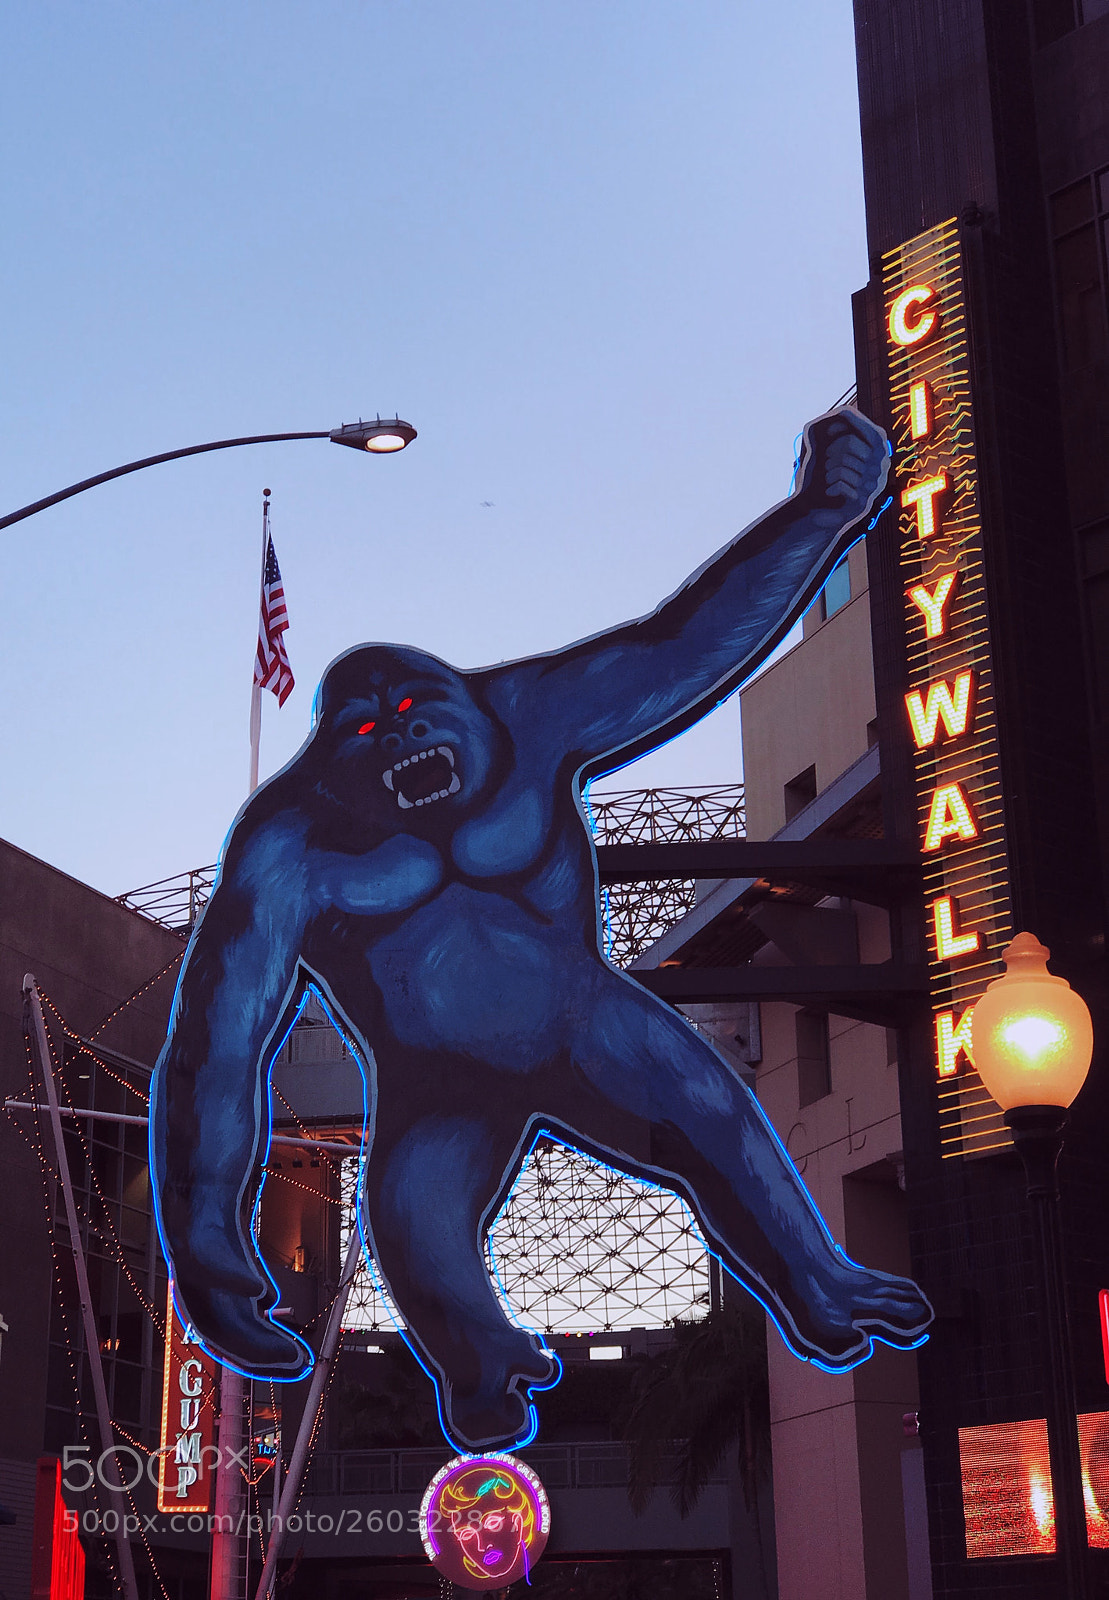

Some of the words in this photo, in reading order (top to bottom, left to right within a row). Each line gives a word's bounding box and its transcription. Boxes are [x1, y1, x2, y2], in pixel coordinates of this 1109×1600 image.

[889, 283, 980, 1078] CITYWALK
[174, 1359, 204, 1498] GUMP
[447, 1458, 461, 1470] THE
[516, 1463, 535, 1481] GIRLS
[432, 1467, 449, 1484] PASS
[421, 1485, 436, 1516] PORTALS
[537, 1488, 547, 1503] THE
[419, 1519, 429, 1541] THESE
[540, 1504, 549, 1534] WORLD
